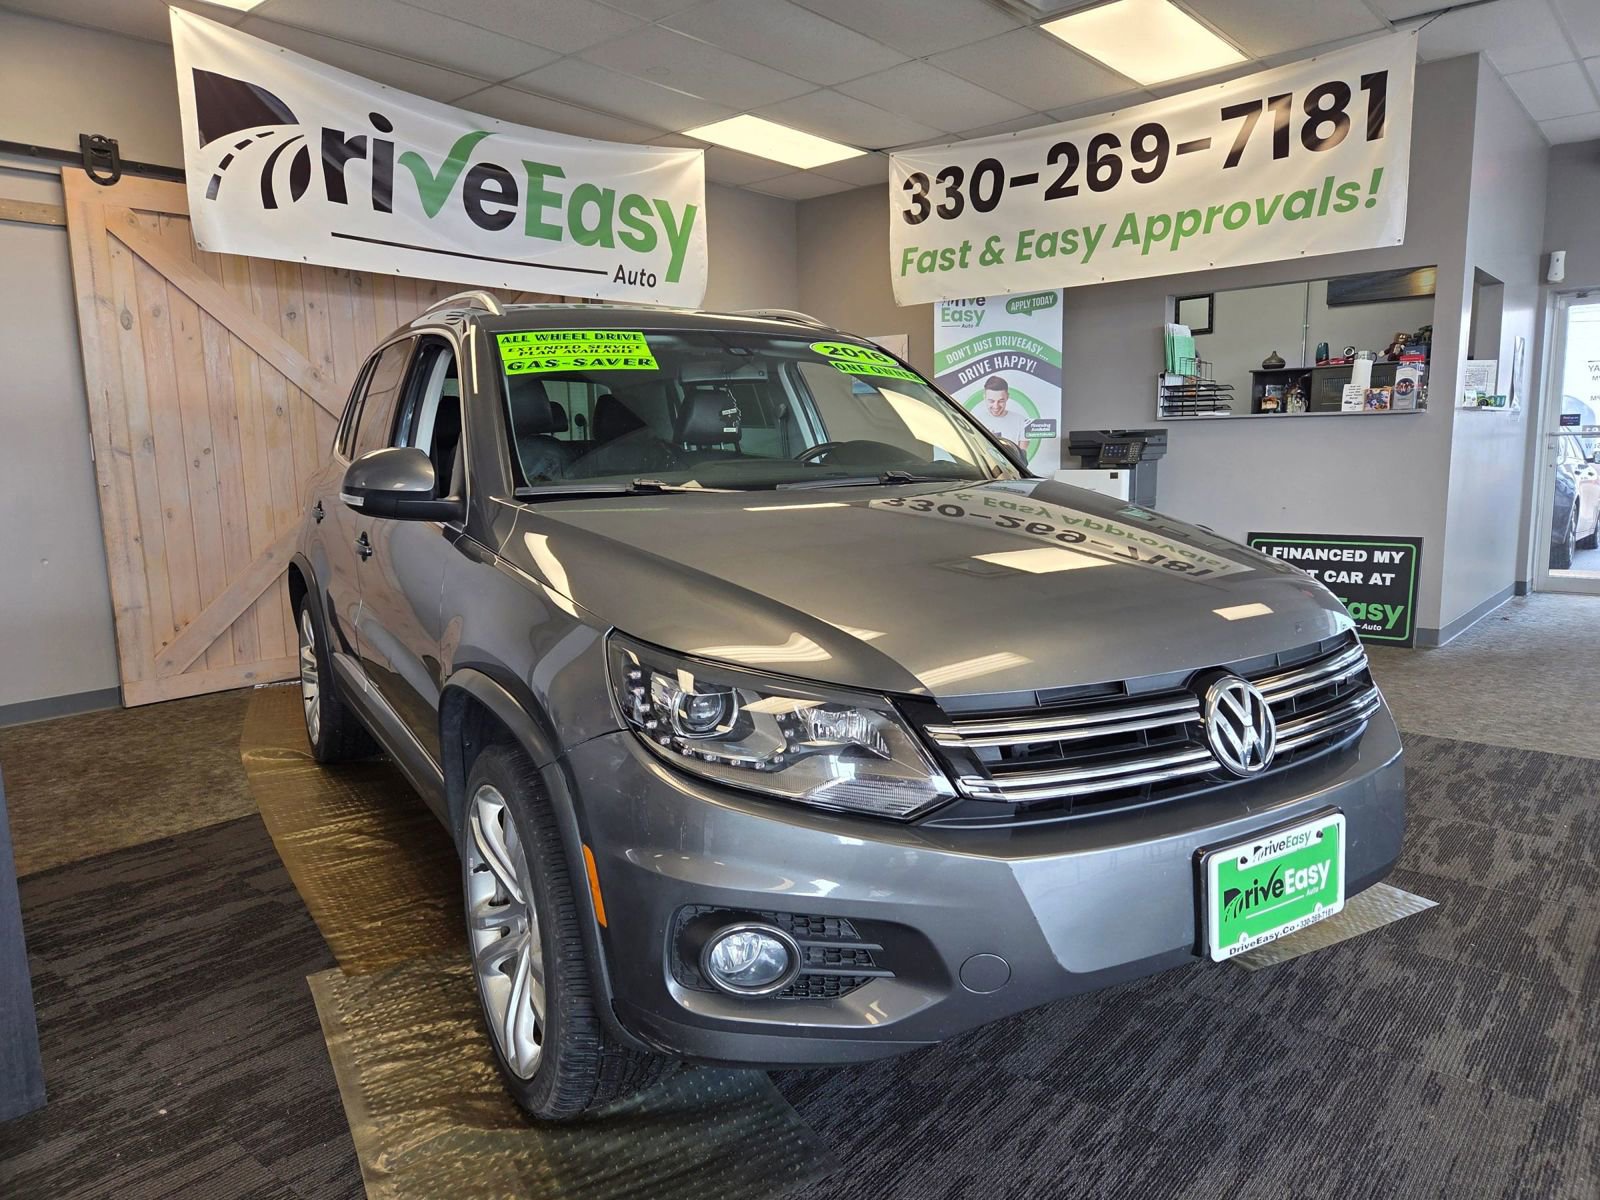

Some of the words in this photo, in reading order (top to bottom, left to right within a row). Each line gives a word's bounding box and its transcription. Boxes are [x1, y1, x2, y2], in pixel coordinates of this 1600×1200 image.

[901, 70, 1389, 227] 330-269-7181
[192, 68, 698, 284] DriveEasy
[900, 239, 972, 277] Fast
[978, 234, 1005, 267] &
[1015, 222, 1107, 264] Easy
[1112, 167, 1384, 257] Approvals!
[613, 264, 657, 289] Auto
[1011, 301, 1031, 311] APPLY
[1032, 295, 1054, 308] TODAY
[941, 308, 986, 327] Easy
[501, 336, 529, 344] ALL
[535, 332, 590, 341] WHEEL
[595, 332, 642, 341] DRIVE
[508, 344, 581, 353] EXTENDED
[518, 349, 557, 357] PLAN
[562, 347, 634, 355] AVAILABLE
[823, 345, 891, 364] 2016
[946, 345, 971, 364] DON'T
[972, 338, 993, 355] JUST
[507, 358, 653, 371] GAS-SAVER
[835, 362, 868, 373] ONE
[958, 358, 992, 385] DRIVE
[994, 355, 1038, 373] HAPPY!
[1272, 547, 1368, 562] FINANCED
[1373, 550, 1405, 564] MY
[1323, 570, 1363, 584] CAR
[1369, 573, 1396, 586] AT
[1361, 623, 1382, 631] Auto
[1252, 830, 1313, 863] DriveEasy
[1223, 858, 1332, 923] DriveEasy
[1229, 924, 1296, 956] DriveEasy.Co
